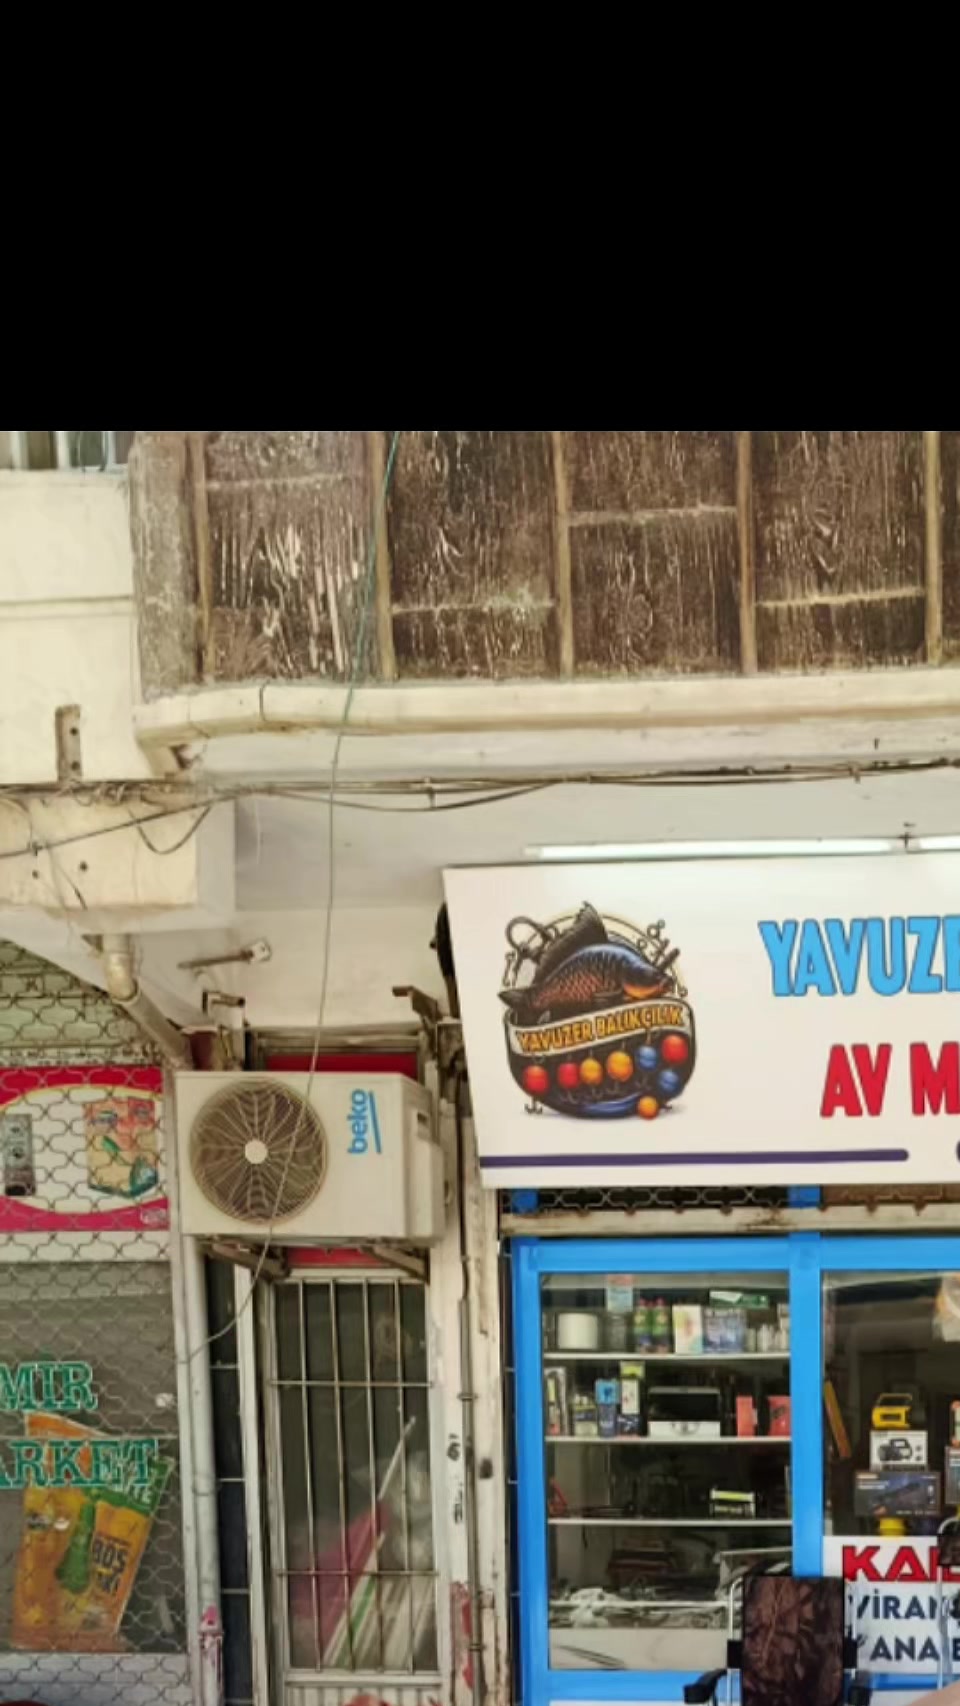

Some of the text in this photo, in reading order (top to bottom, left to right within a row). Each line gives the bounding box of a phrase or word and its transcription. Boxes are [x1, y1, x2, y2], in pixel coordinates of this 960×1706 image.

[515, 1020, 593, 1052] YAVUZER
[820, 1043, 892, 1117] AV
[346, 1088, 369, 1154] beko
[869, 1635, 940, 1662] ANA
